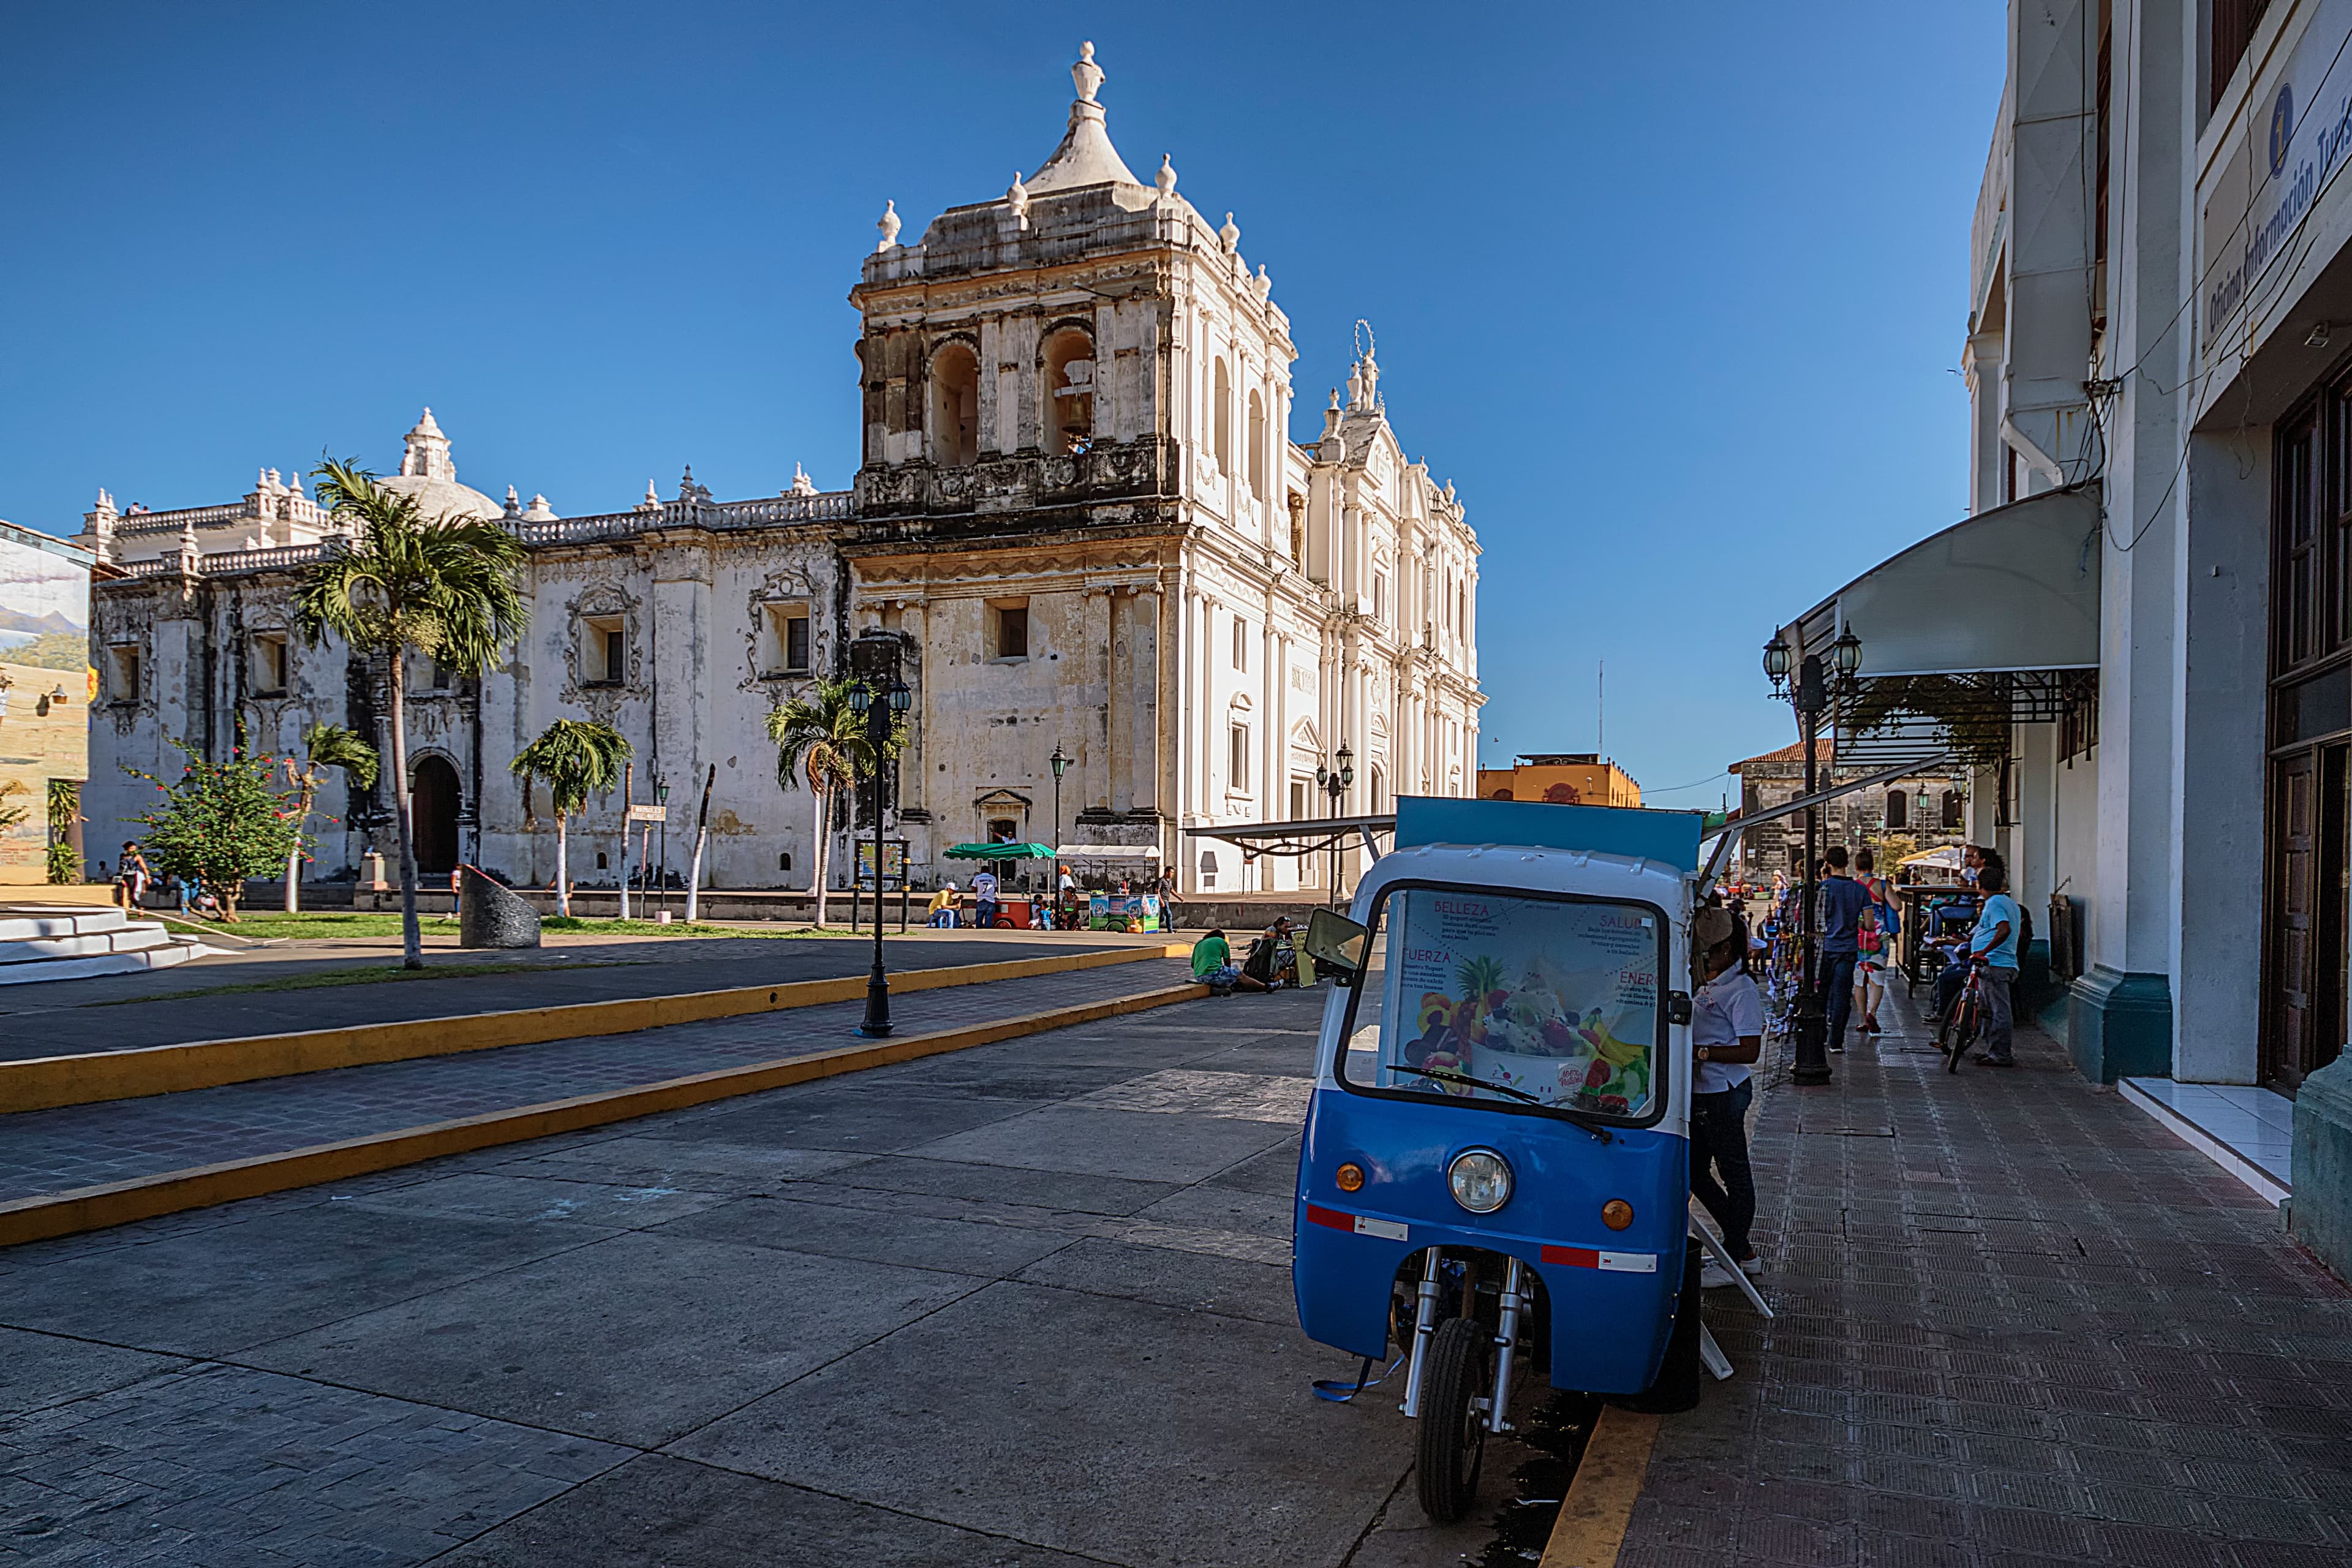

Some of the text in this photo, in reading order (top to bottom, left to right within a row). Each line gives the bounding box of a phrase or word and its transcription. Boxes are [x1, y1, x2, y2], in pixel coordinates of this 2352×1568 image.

[2210, 266, 2242, 334] Oficina
[982, 882, 989, 894] 7
[1434, 901, 1490, 916] BELLEZA
[1599, 915, 1642, 929] SALUD
